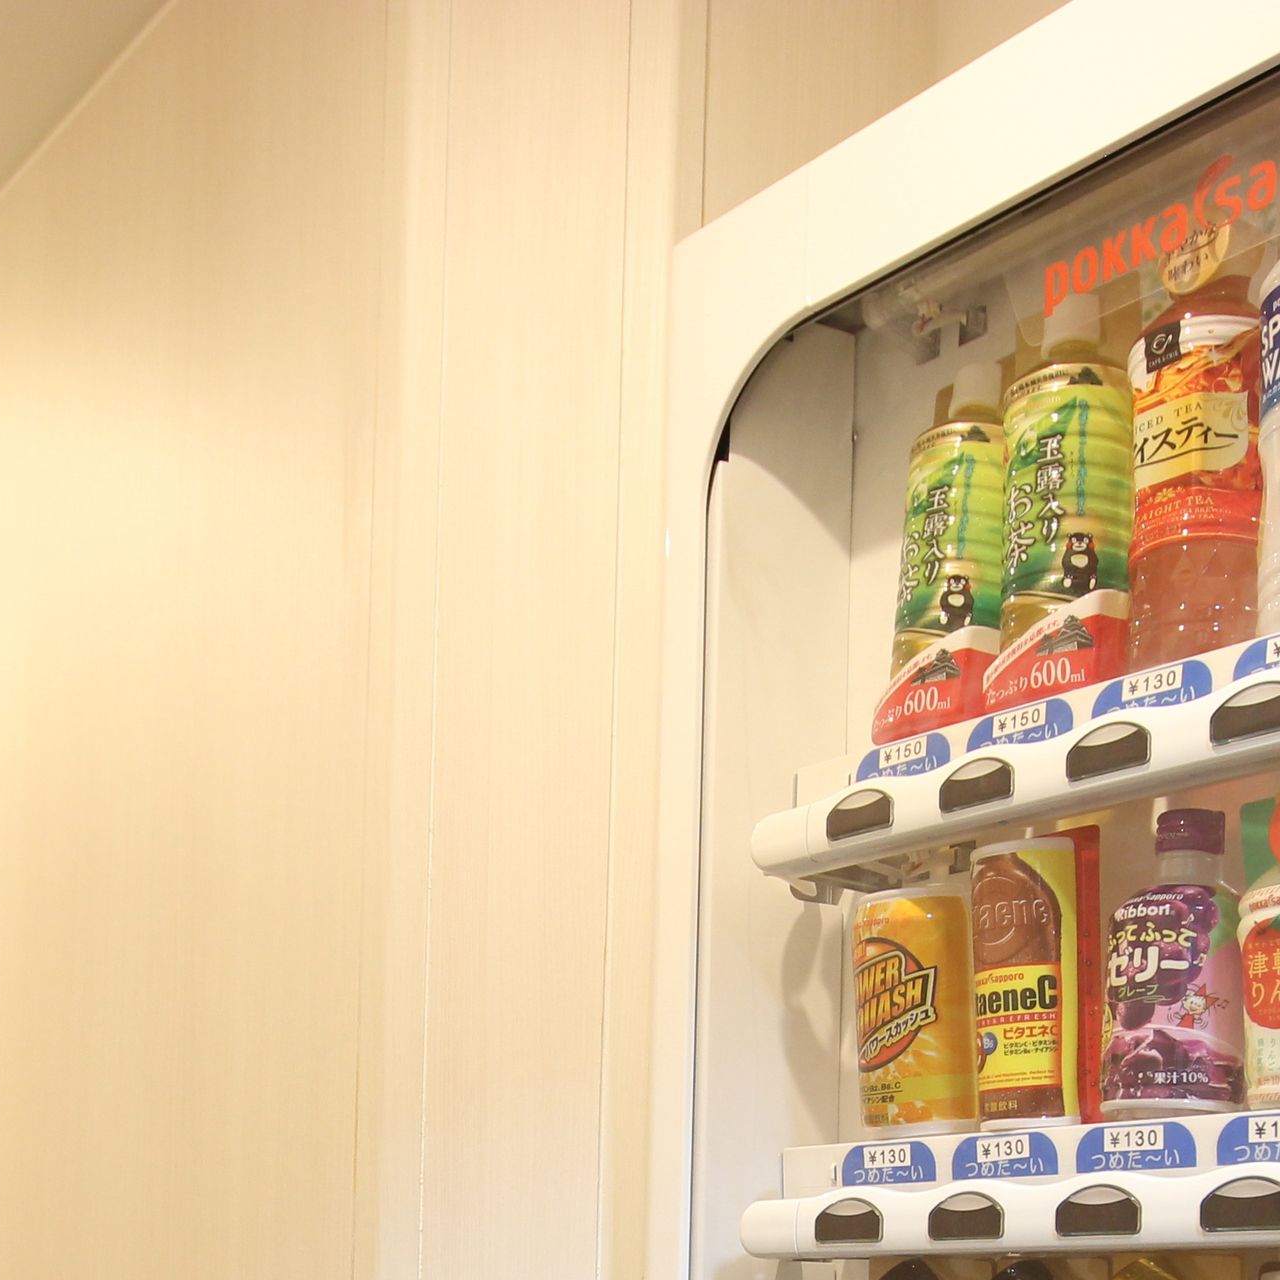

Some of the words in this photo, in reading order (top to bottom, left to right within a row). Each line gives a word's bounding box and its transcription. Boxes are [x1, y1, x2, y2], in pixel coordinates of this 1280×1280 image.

[1174, 403, 1203, 417] TEA
[1036, 434, 1065, 544] 玉露入り
[1186, 496, 1214, 506] TEA
[922, 485, 951, 585] 玉露入り
[1006, 483, 1036, 570] お茶
[1128, 669, 1177, 694] ¥130
[997, 708, 1041, 733] ¥150
[883, 739, 922, 765] ¥150
[1114, 904, 1170, 921] Ribbon
[1109, 946, 1189, 986] ゼリー
[1119, 984, 1158, 998] グレープ
[1153, 1071, 1209, 1085] 果汁10%
[980, 1138, 1025, 1158] ¥130
[1109, 1129, 1159, 1148] ¥130
[867, 1147, 907, 1165] ¥130
